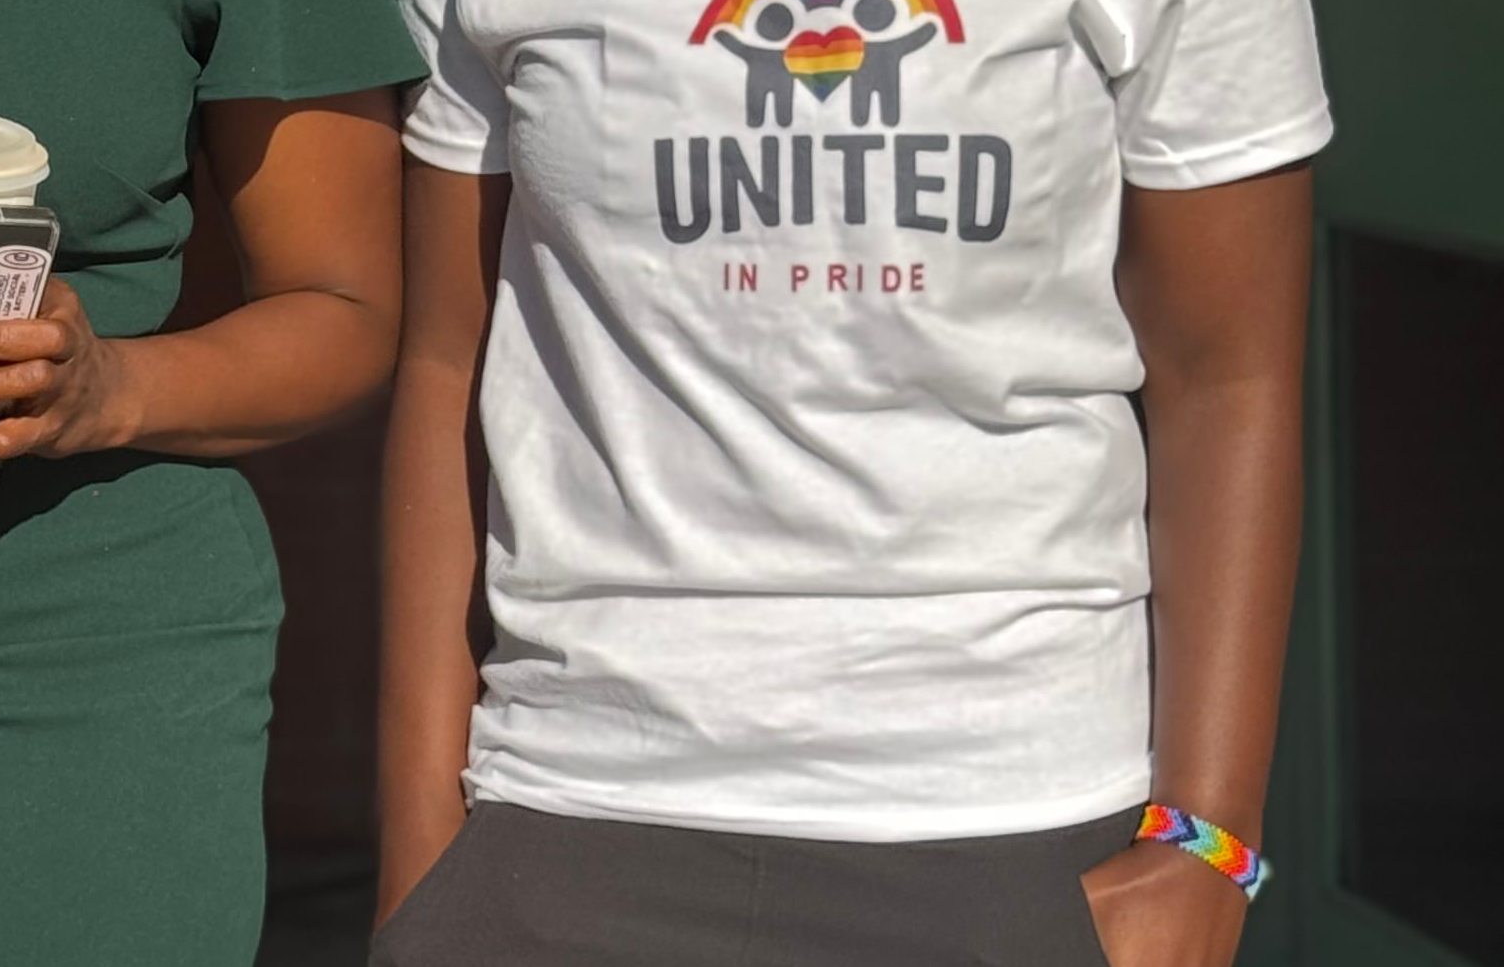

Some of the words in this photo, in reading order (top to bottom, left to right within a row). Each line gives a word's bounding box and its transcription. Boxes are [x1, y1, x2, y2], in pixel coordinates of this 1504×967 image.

[654, 133, 1012, 245] UNITED
[724, 263, 758, 292] IN
[791, 262, 926, 294] PRIDE
